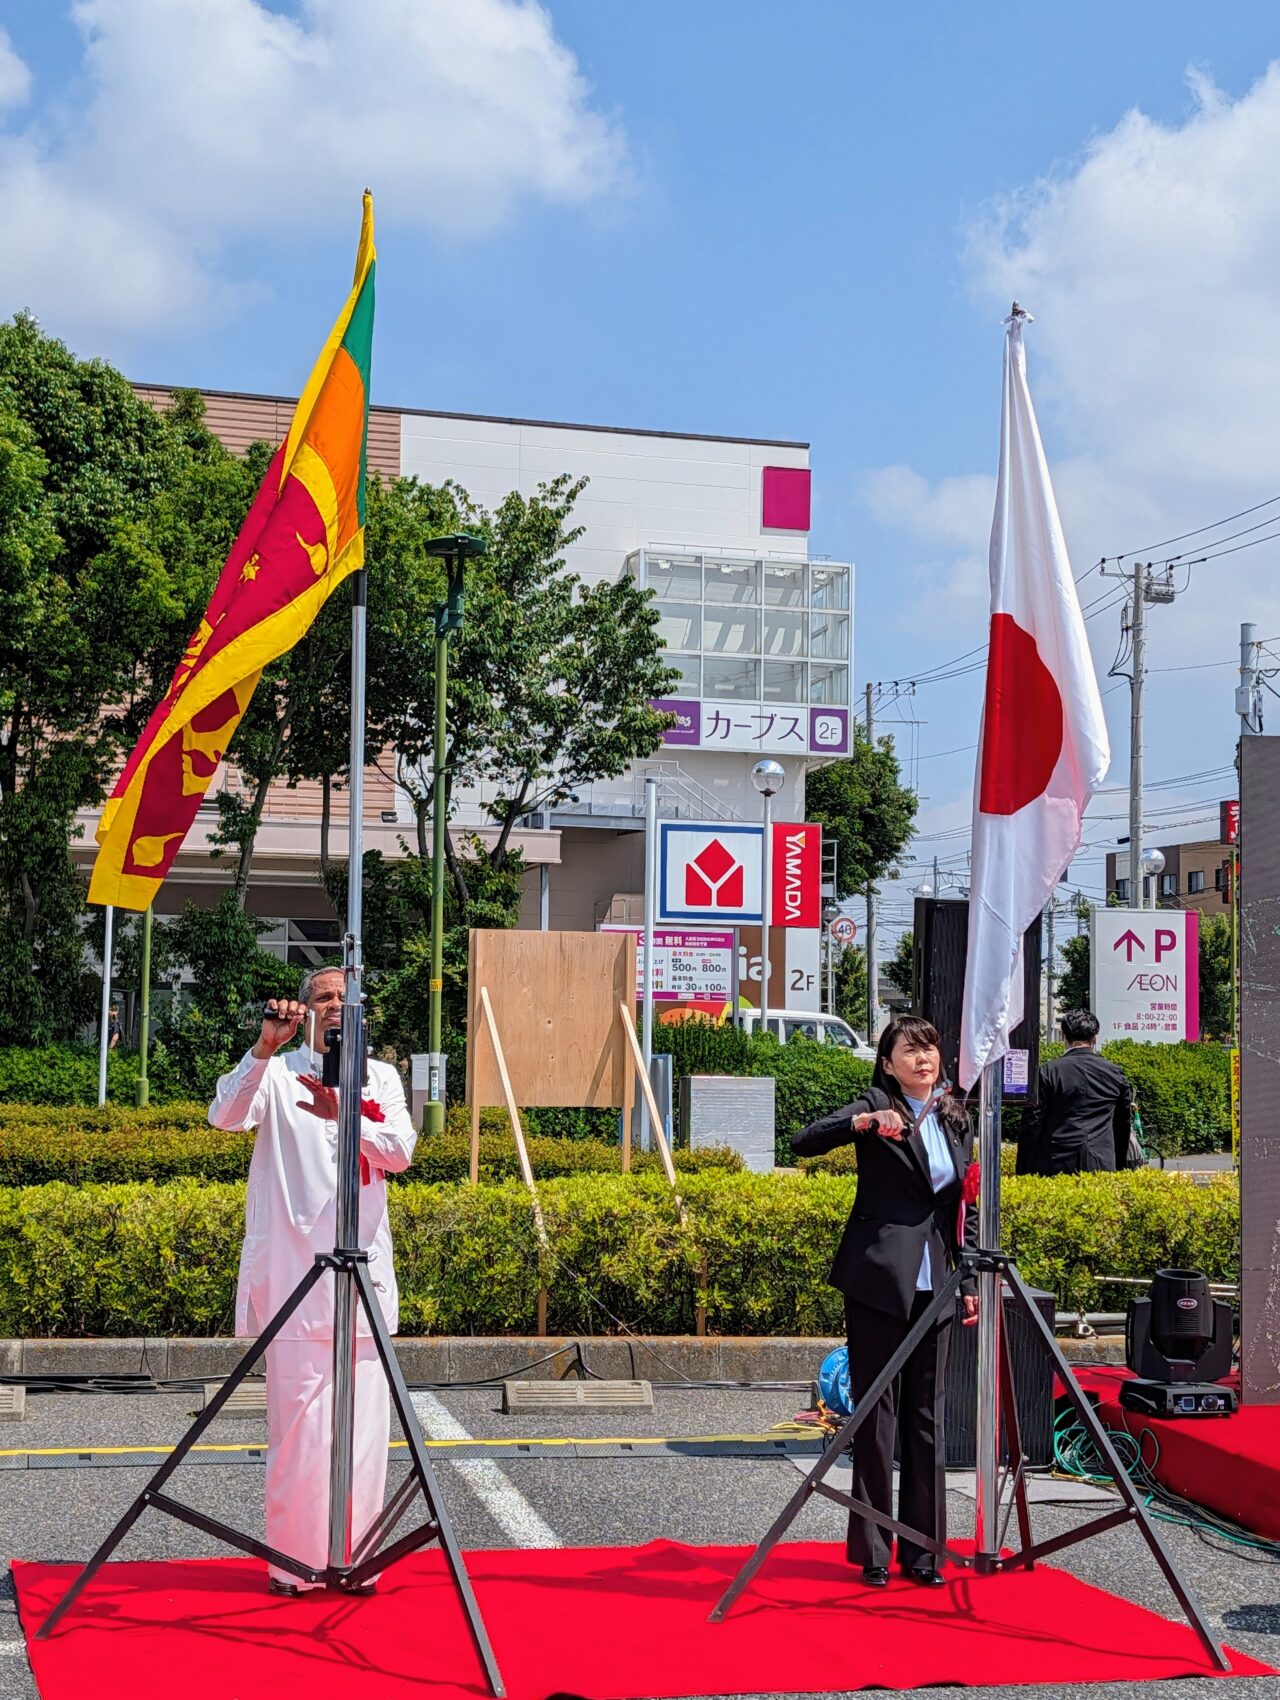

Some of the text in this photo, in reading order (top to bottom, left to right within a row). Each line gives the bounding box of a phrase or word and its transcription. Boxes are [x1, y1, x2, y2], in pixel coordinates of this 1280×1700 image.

[705, 710, 805, 742] カーブス
[818, 722, 838, 740] 2F
[785, 831, 806, 921] YAMADA
[837, 924, 852, 936] 40
[1155, 929, 1177, 963] P
[790, 969, 815, 991] 2F
